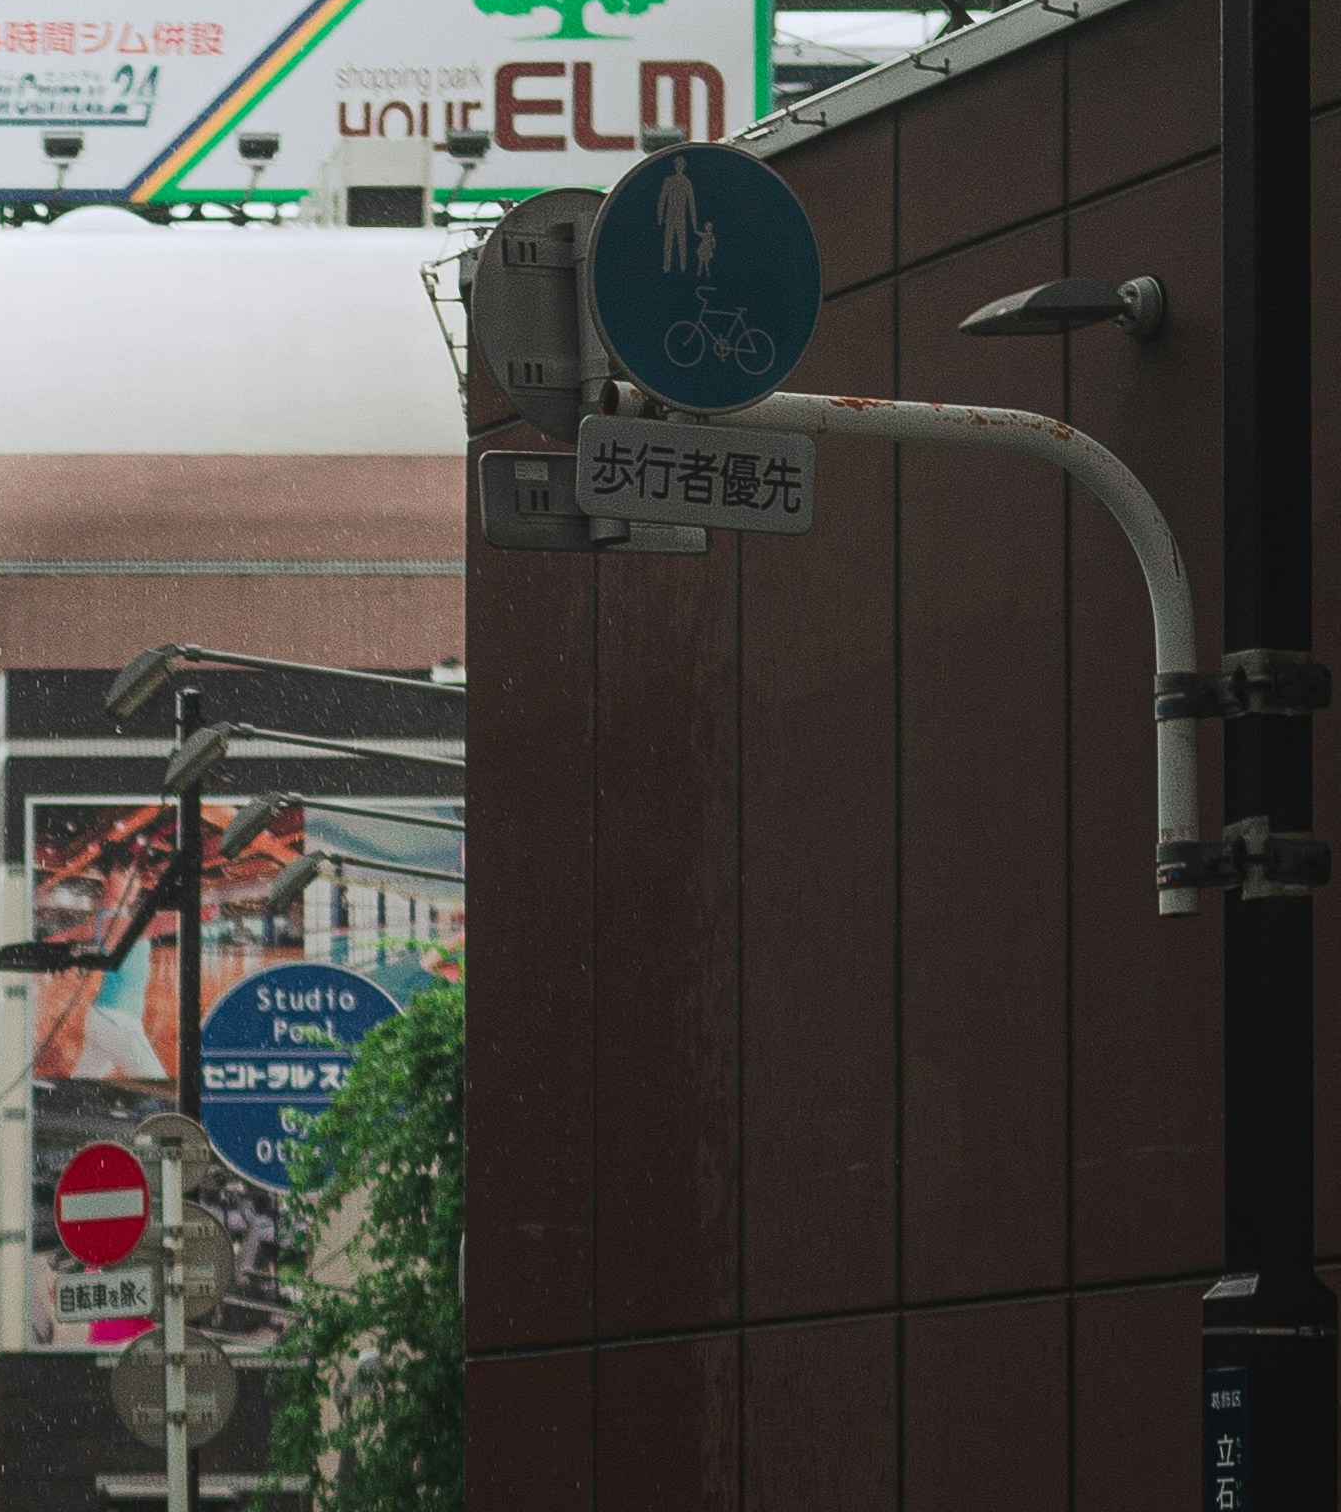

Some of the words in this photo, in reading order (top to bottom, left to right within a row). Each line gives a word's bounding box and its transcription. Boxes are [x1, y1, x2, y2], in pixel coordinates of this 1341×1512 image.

[590, 441, 803, 515] 歩行者優先
[256, 986, 356, 1013] Studio
[273, 1017, 336, 1044] Pol
[60, 1279, 148, 1313] 自転車を除く
